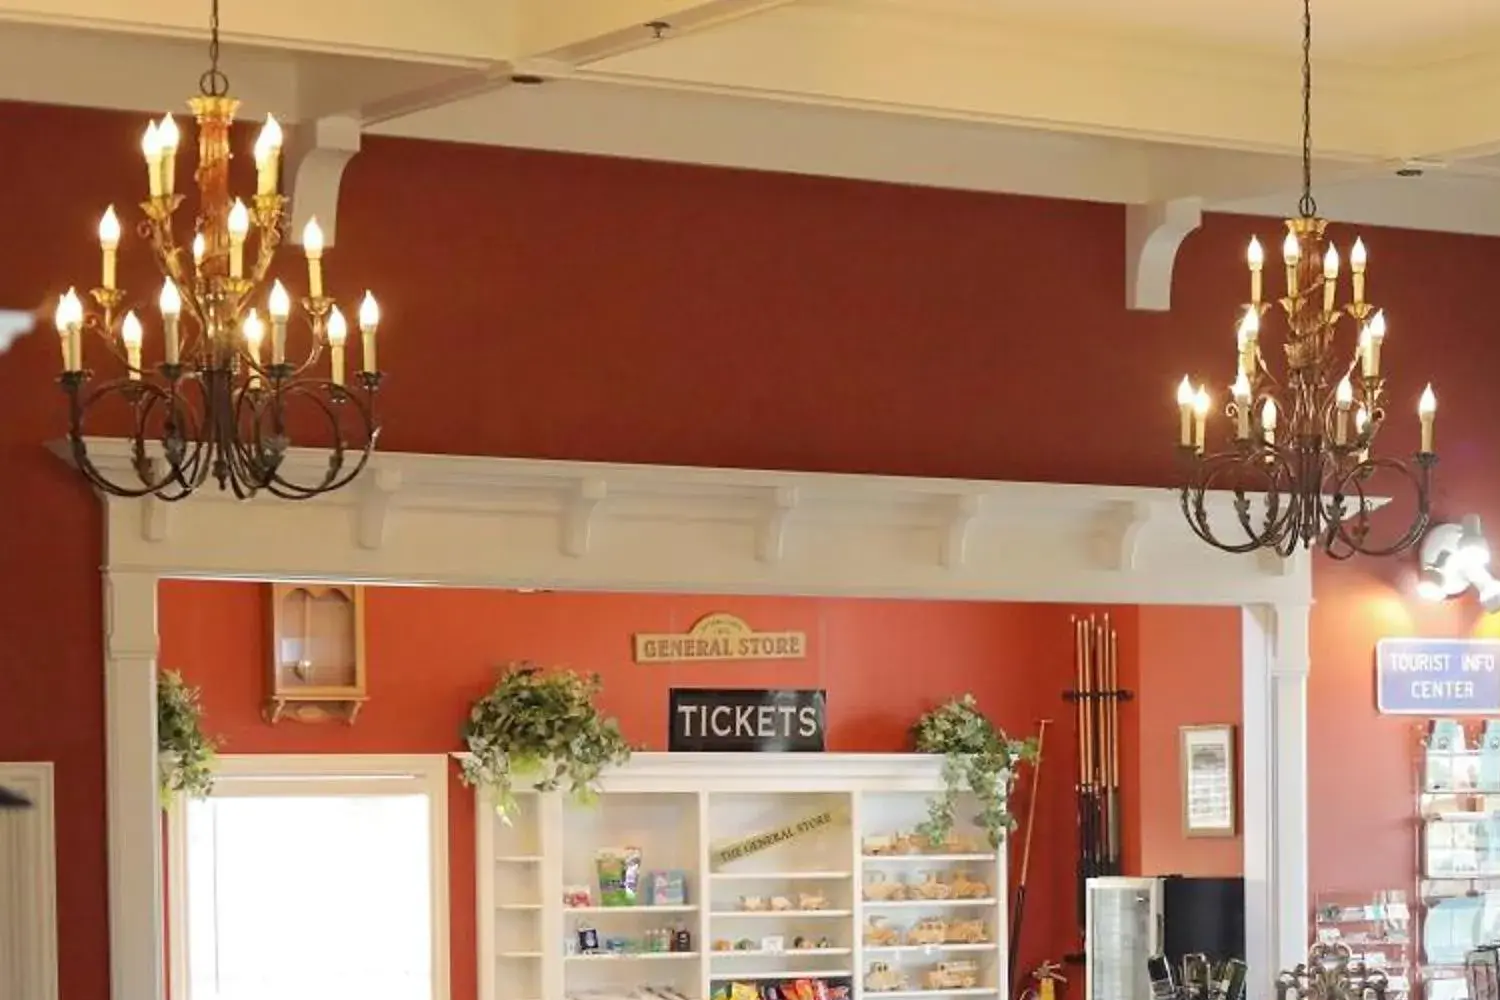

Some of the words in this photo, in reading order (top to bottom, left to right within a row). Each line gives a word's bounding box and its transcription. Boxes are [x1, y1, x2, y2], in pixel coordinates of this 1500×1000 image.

[644, 637, 734, 659] GENERAL
[738, 635, 802, 656] STORE
[1389, 652, 1451, 673] TOURIST
[1460, 653, 1497, 673] INFO
[1410, 680, 1475, 700] CENTER
[676, 702, 819, 738] TICKETS
[796, 811, 833, 836] STORE
